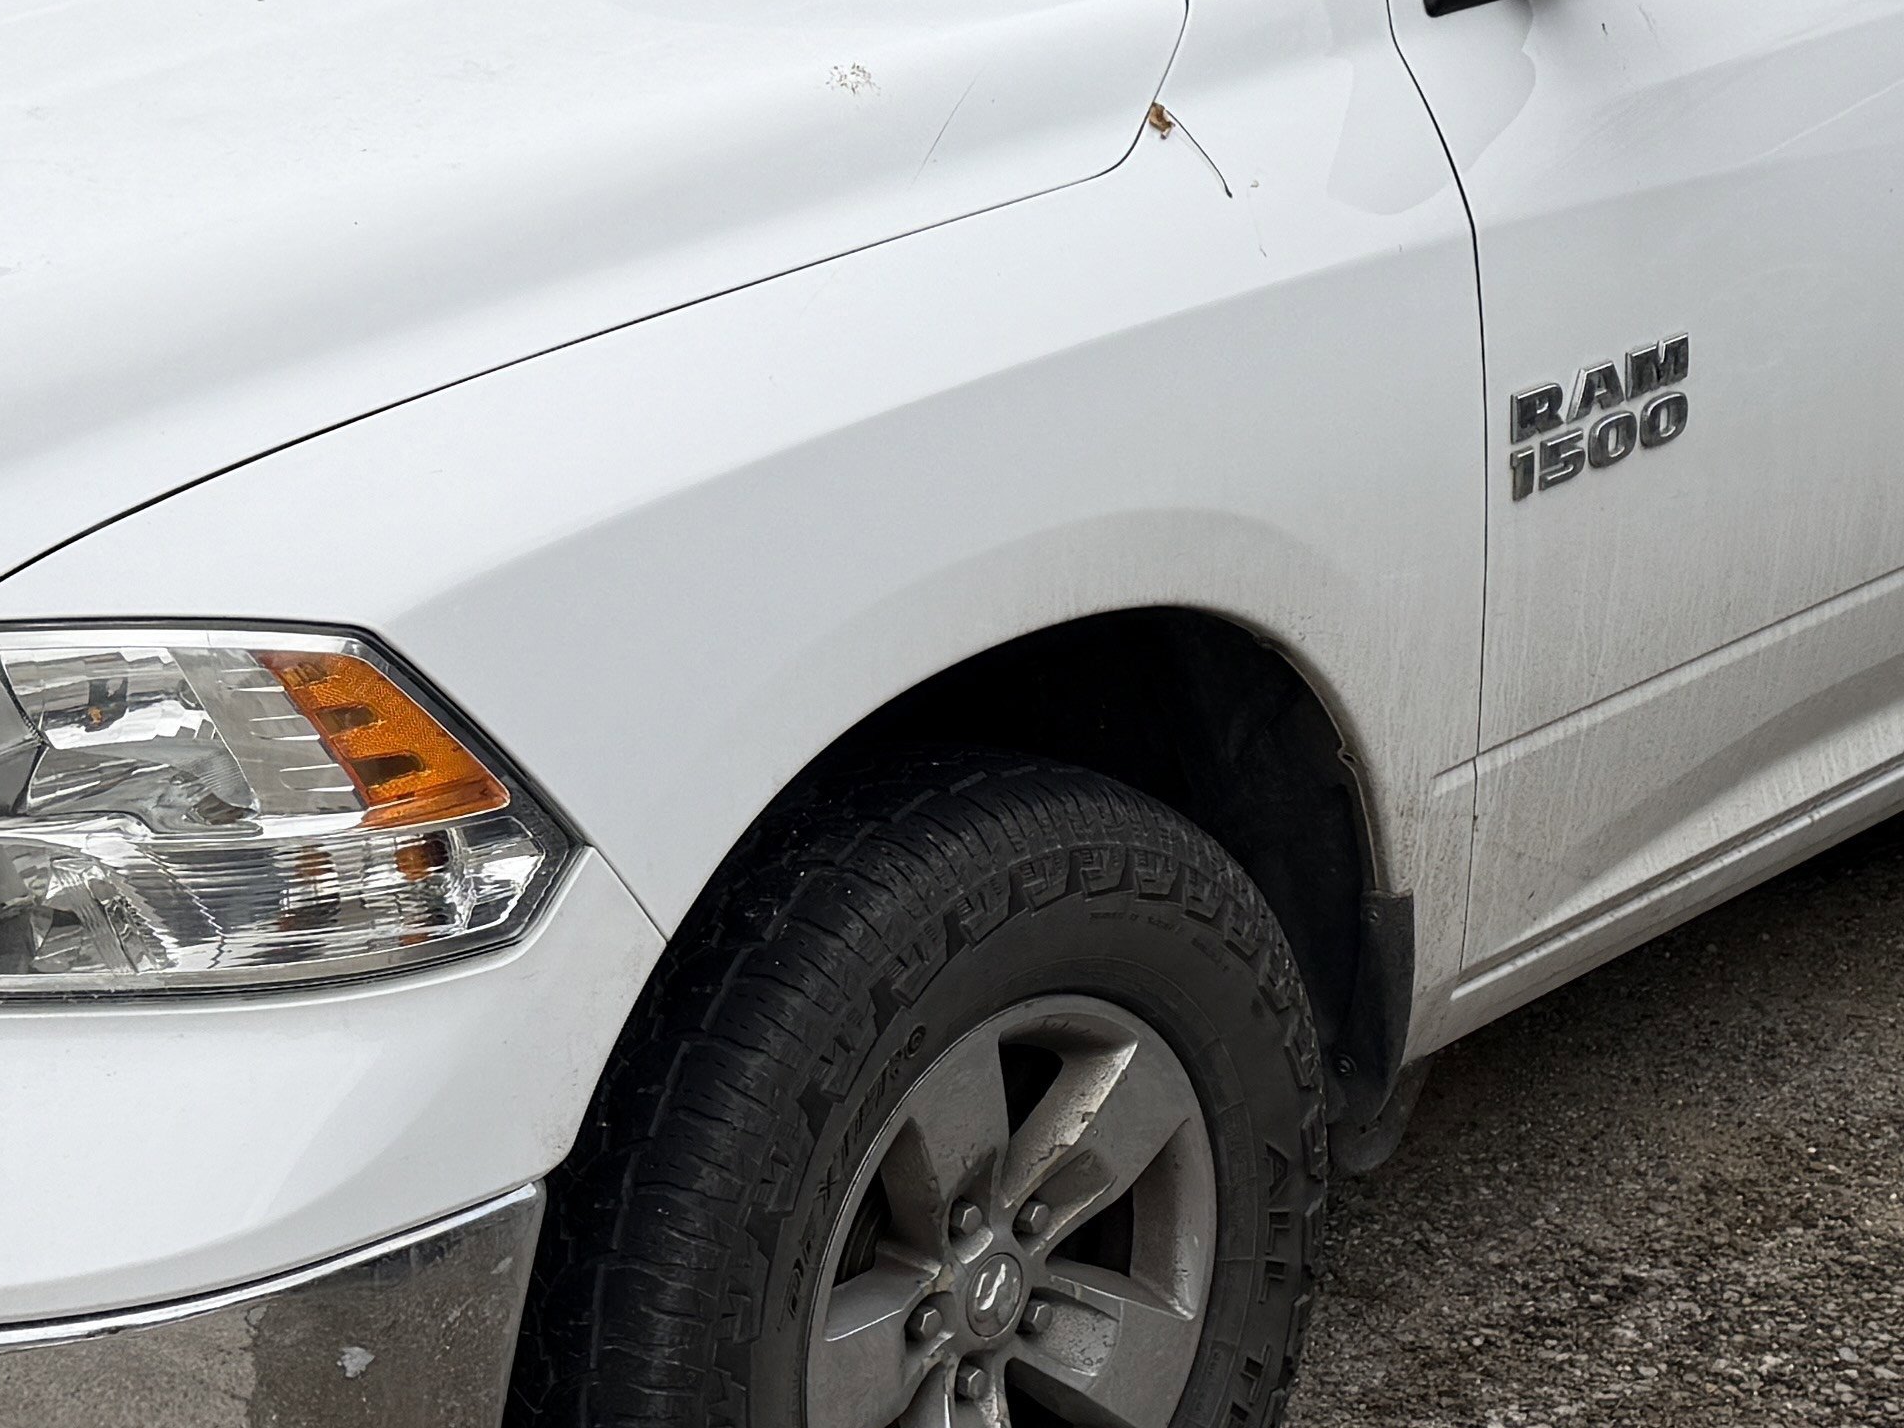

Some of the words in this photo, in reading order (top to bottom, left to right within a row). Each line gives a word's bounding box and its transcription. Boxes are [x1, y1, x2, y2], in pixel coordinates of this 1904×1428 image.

[1508, 331, 1689, 444] RAM
[1508, 391, 1689, 502] 1500
[1256, 1139, 1292, 1305] ALL
